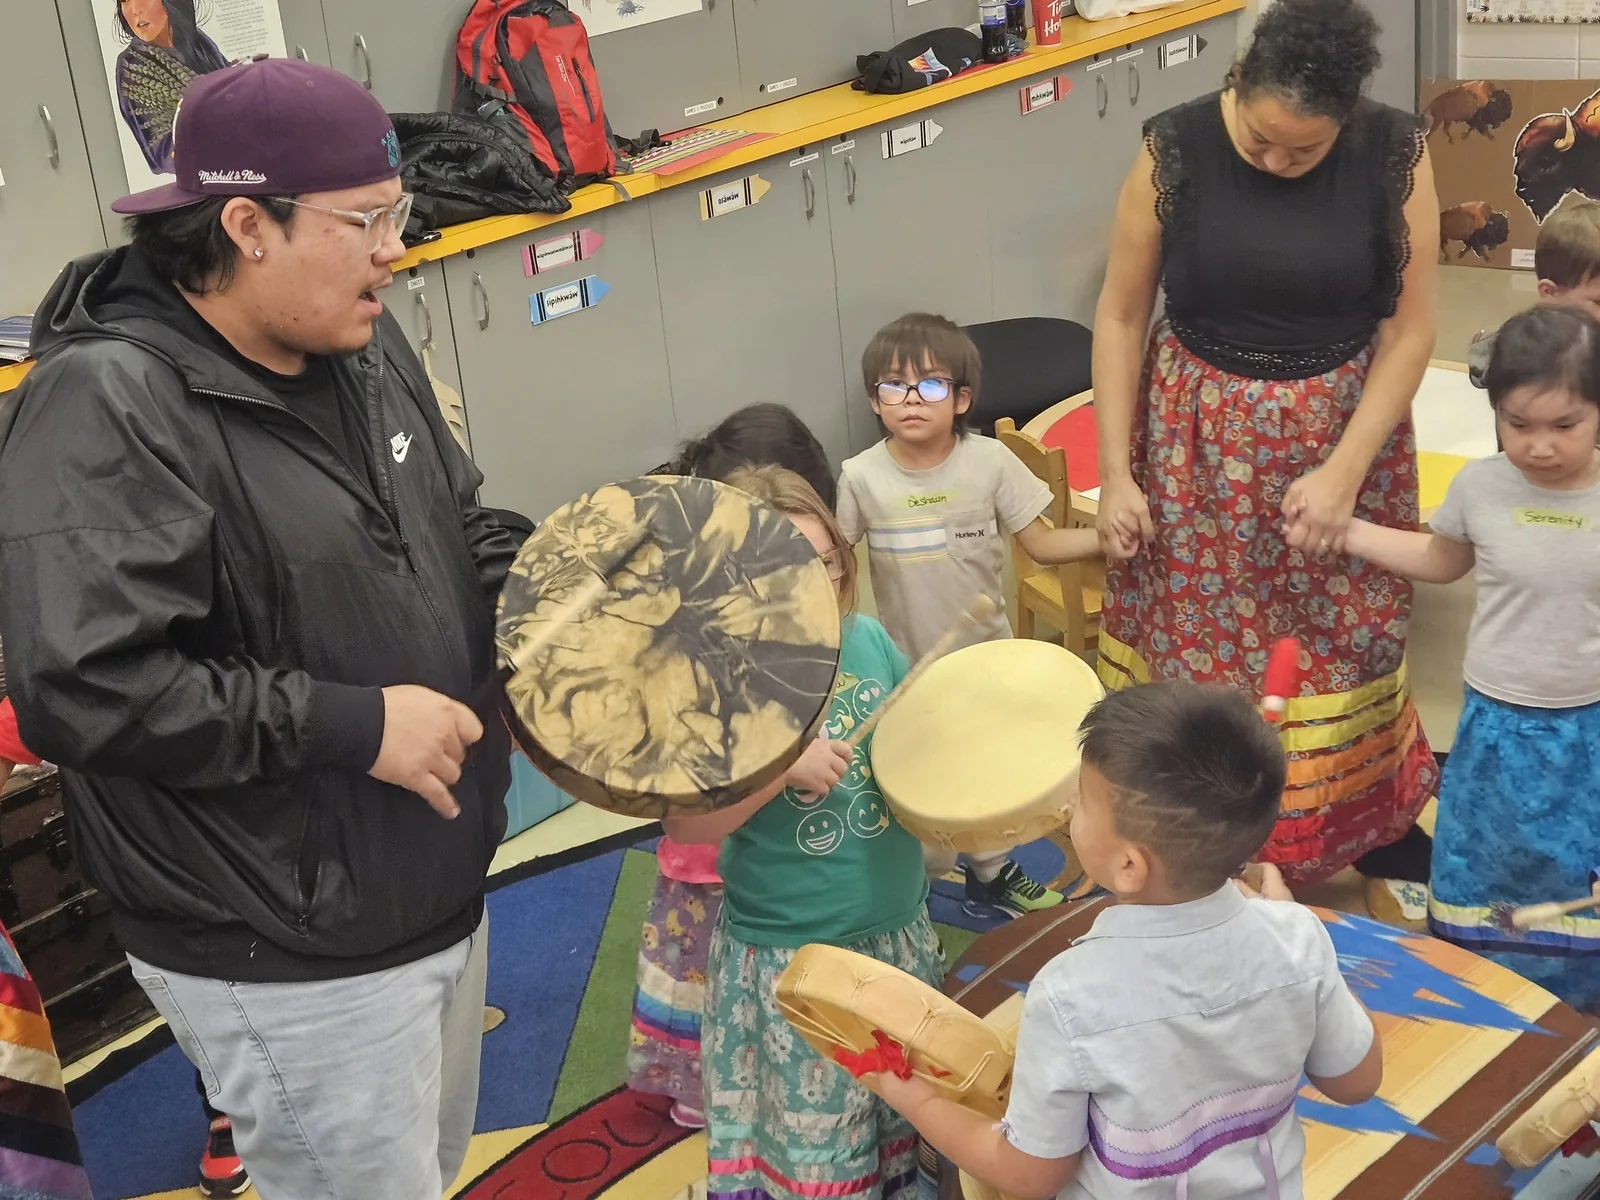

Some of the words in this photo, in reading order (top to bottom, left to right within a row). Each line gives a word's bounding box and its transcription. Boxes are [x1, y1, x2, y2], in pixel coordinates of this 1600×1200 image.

[1047, 0, 1061, 17] Ti
[1044, 18, 1061, 37] Ho
[198, 169, 234, 181] Mitchell
[234, 170, 242, 181] &
[241, 169, 267, 181] Ness
